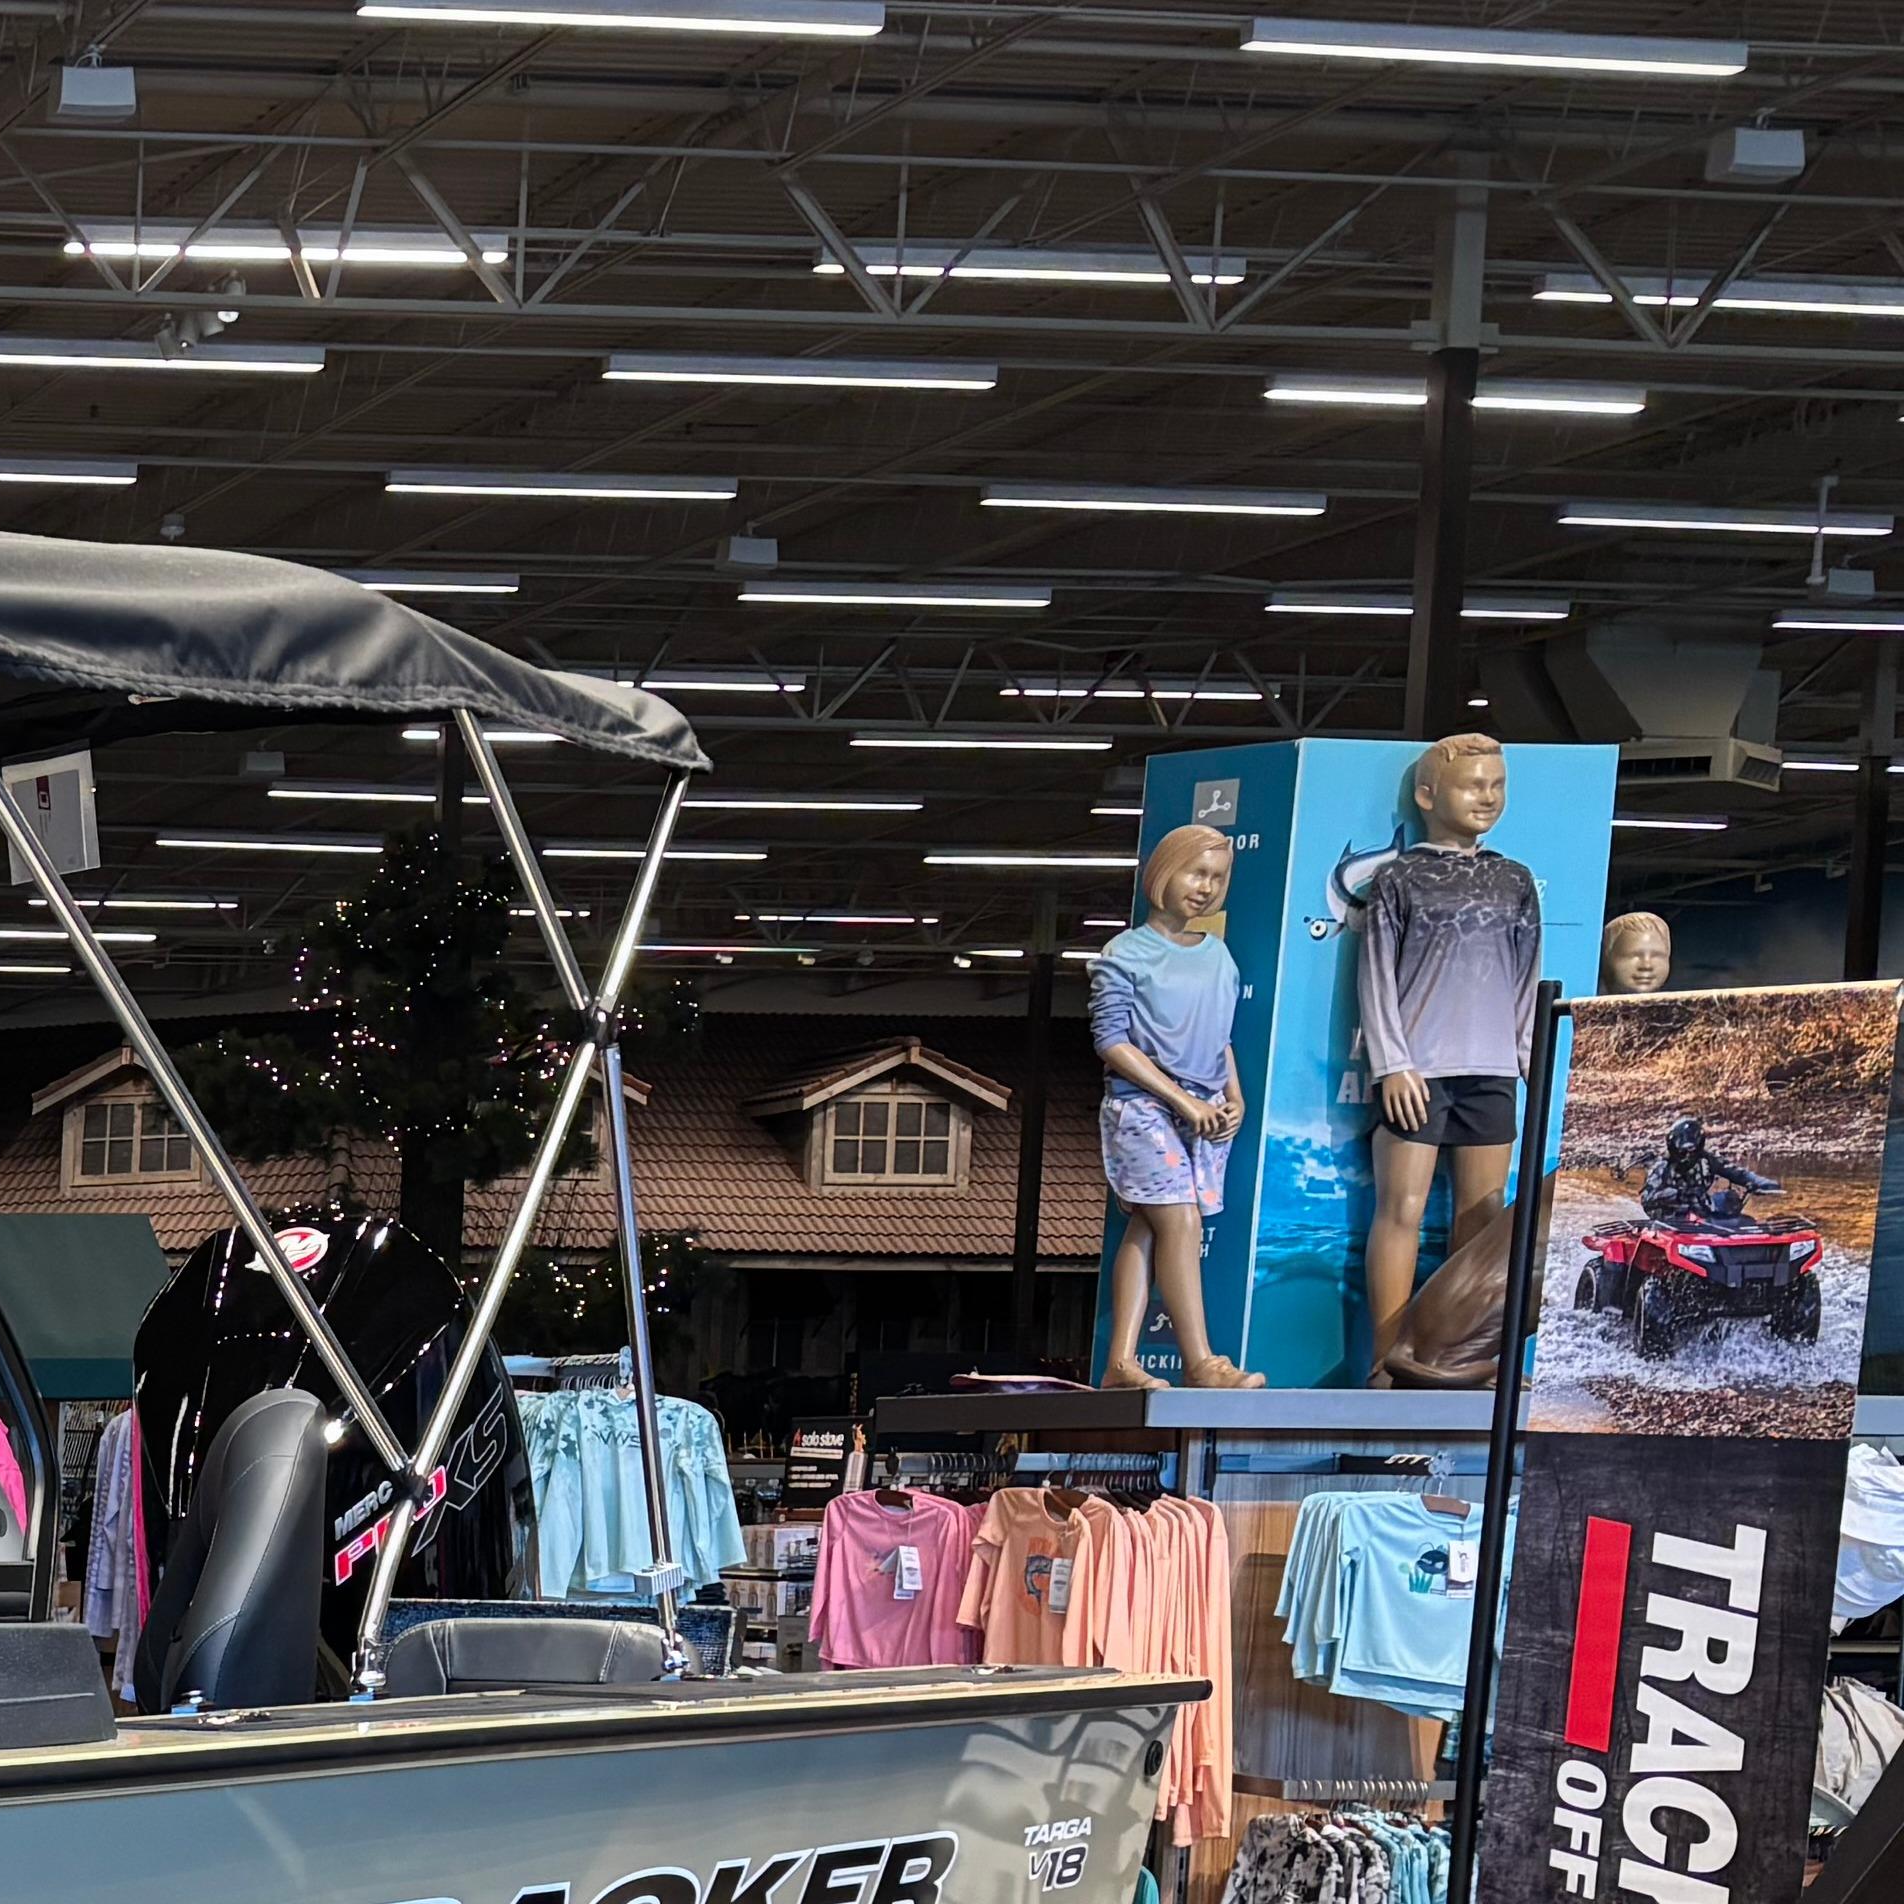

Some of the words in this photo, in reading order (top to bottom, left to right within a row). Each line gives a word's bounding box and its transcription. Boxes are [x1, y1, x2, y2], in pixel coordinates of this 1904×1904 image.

[1023, 1816, 1091, 1847] TARGA
[1548, 1758, 1607, 1899] OFF
[1028, 1843, 1089, 1893] V18
